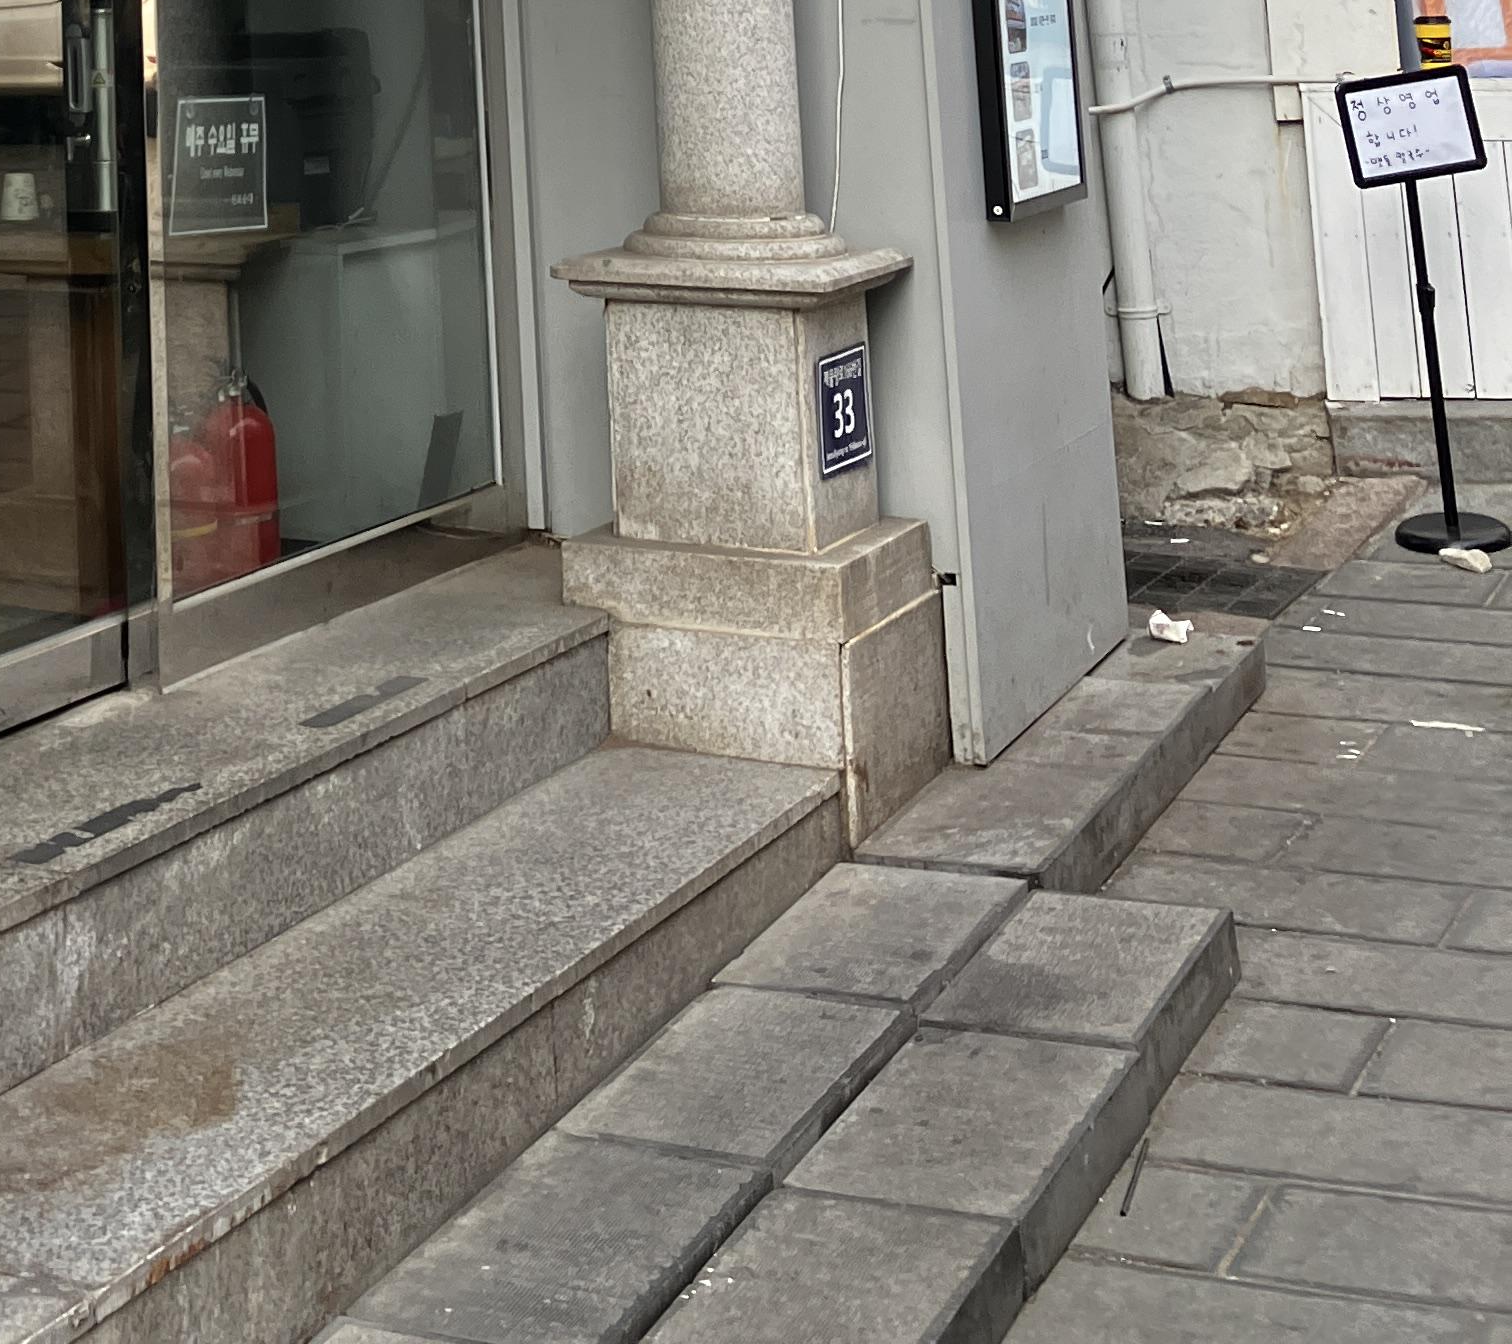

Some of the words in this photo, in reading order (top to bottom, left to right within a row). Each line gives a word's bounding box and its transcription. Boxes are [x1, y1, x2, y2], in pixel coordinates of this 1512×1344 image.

[208, 122, 236, 156] 수요일
[239, 122, 260, 154] 휴무
[833, 388, 855, 439] 33
